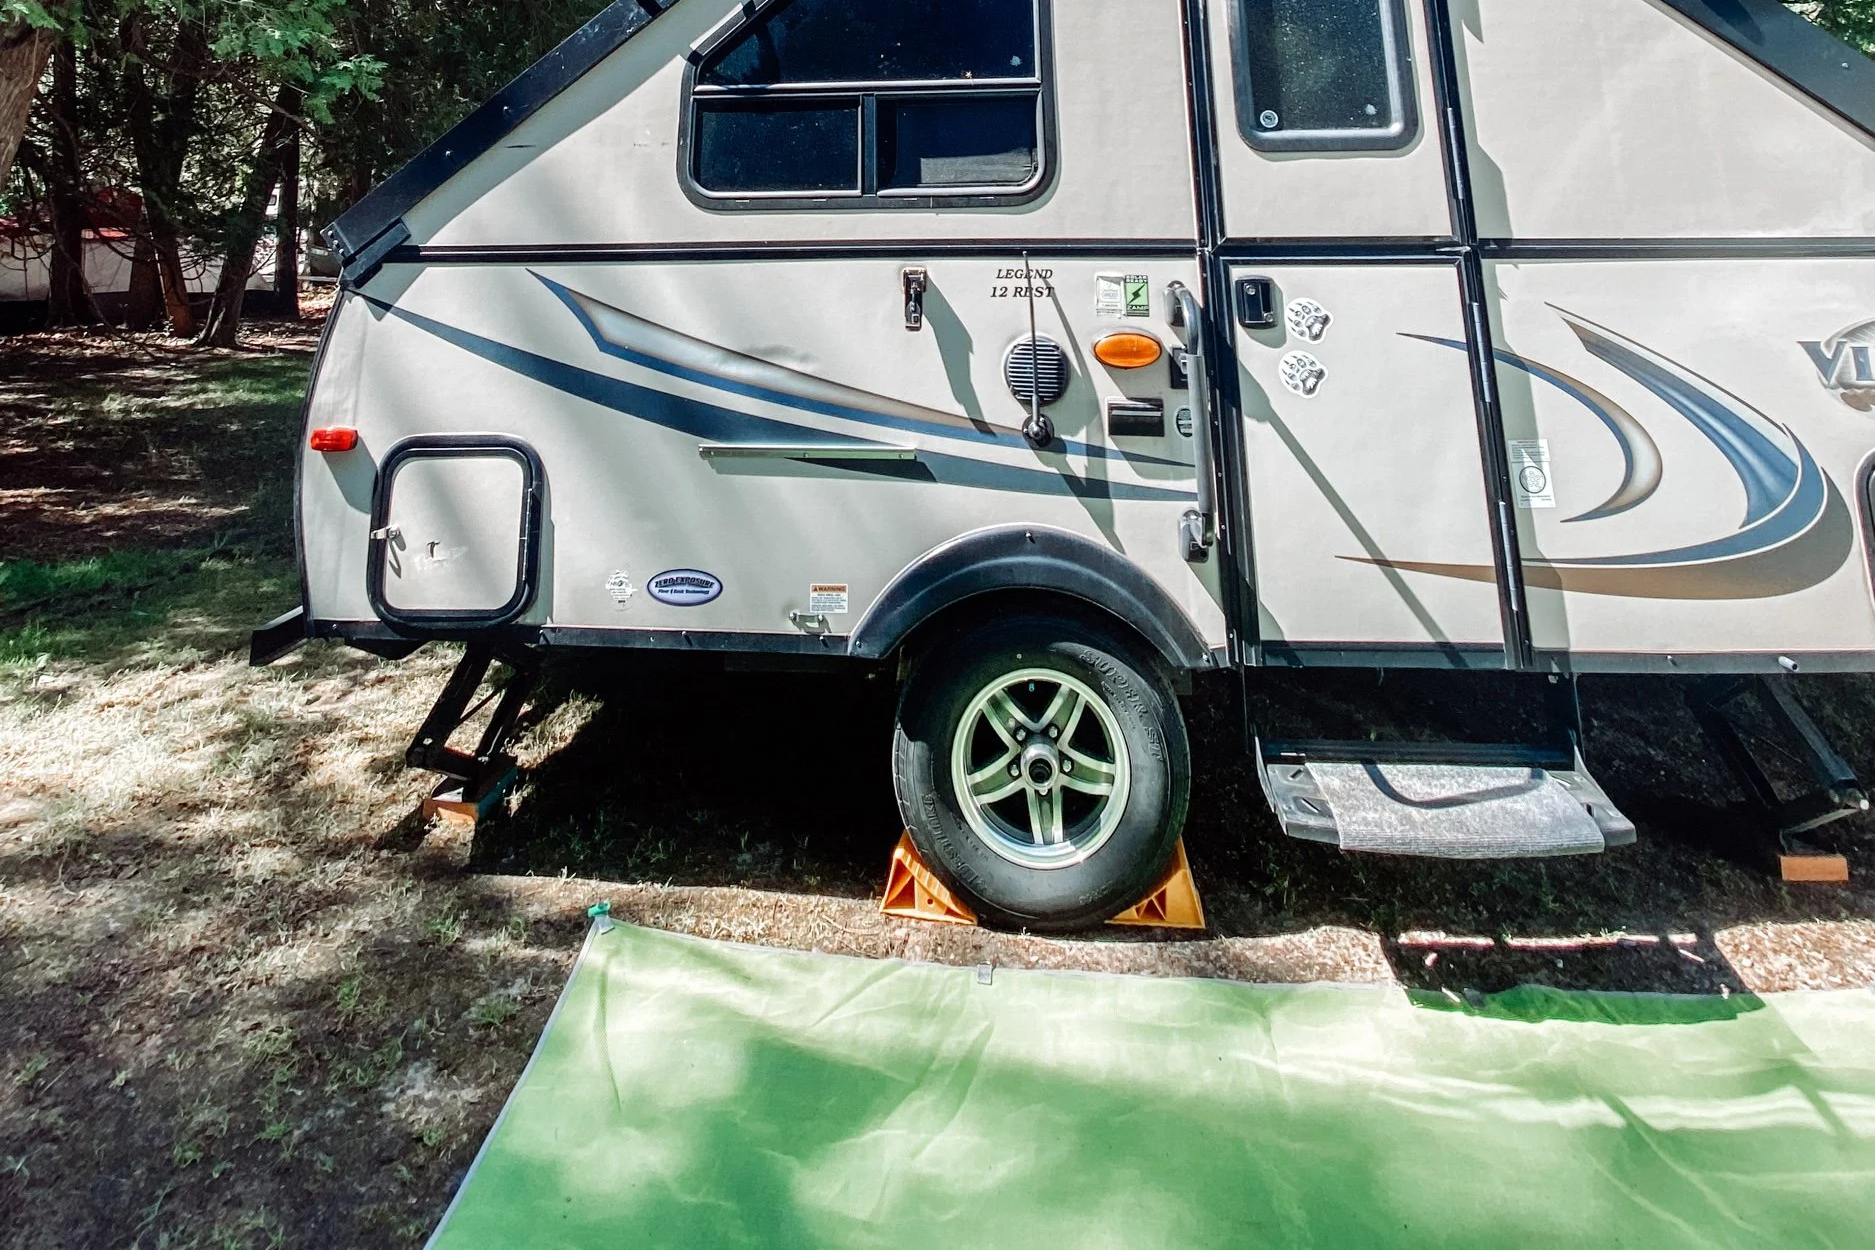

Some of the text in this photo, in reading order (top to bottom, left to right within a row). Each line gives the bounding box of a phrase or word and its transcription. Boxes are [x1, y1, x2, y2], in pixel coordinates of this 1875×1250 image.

[996, 269, 1053, 279] LEGEND
[990, 286, 1008, 298] 12
[655, 577, 715, 588] ZERO EXPOSURE
